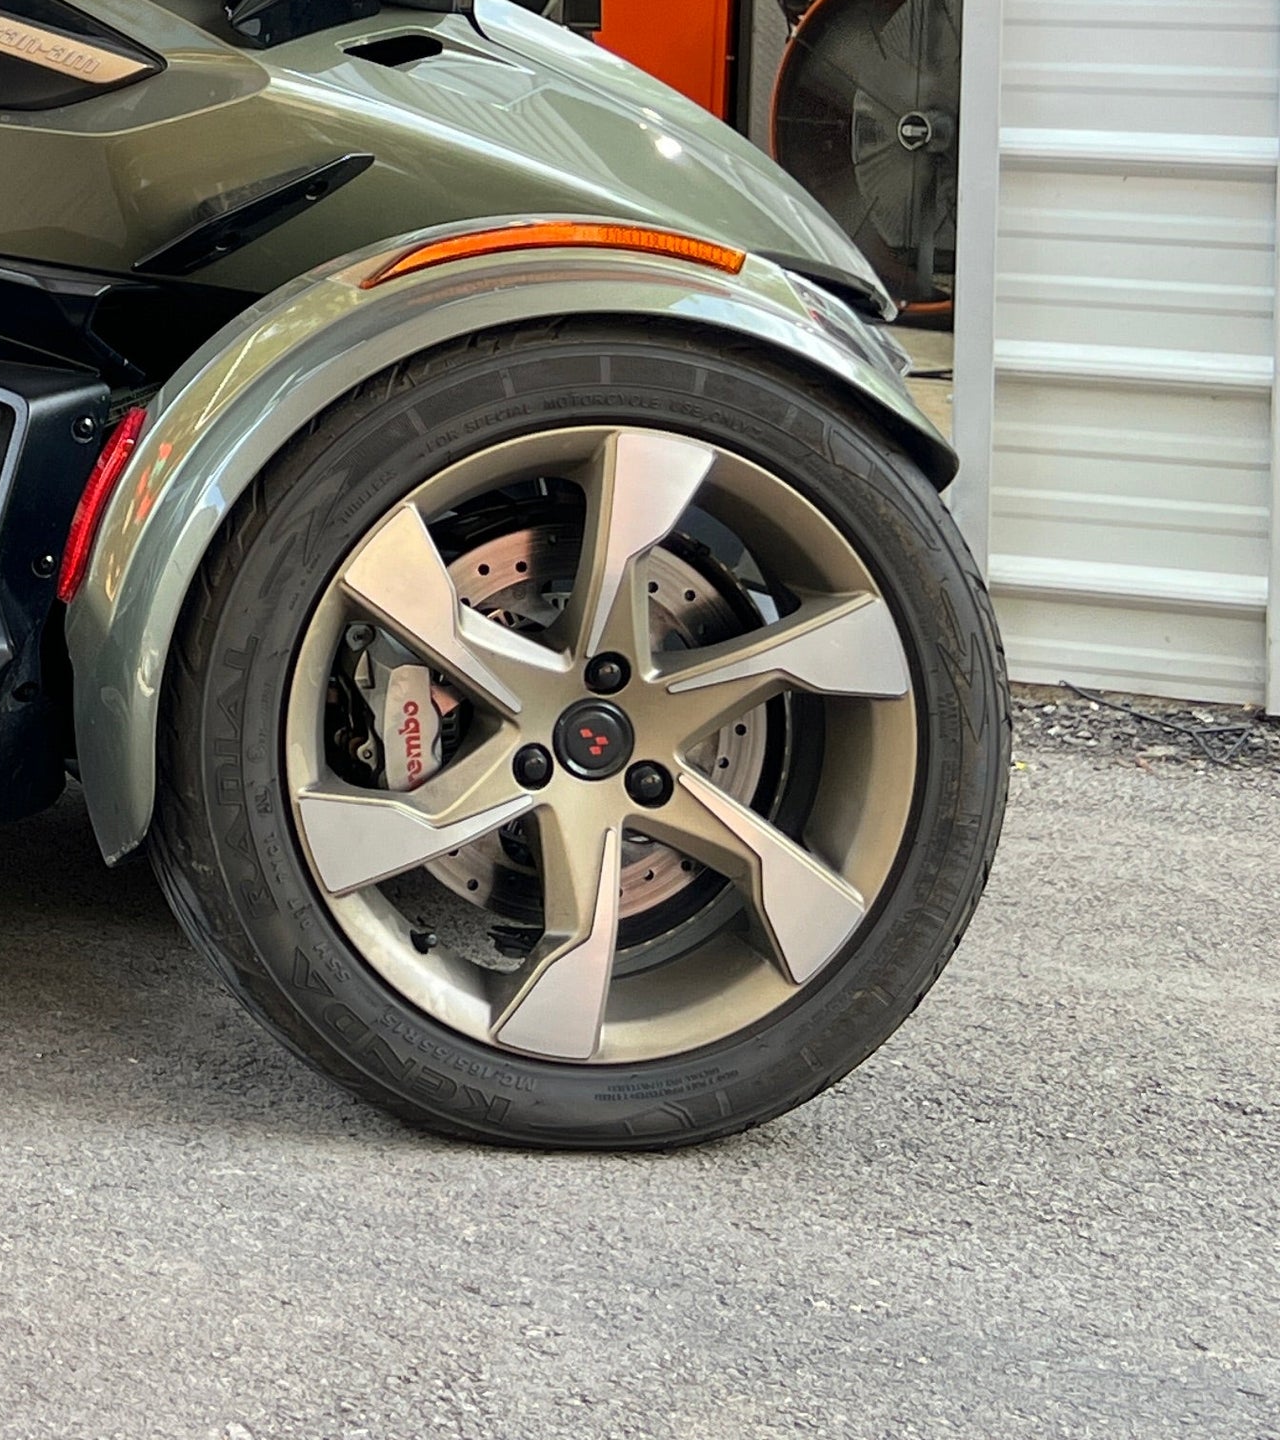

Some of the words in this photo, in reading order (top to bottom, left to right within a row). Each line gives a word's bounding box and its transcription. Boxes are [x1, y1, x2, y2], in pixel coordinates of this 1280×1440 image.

[425, 428, 458, 452] FOR
[461, 400, 532, 435] SPECIAL
[541, 389, 661, 411] MOTORCYCLE
[667, 396, 702, 418] USE
[214, 631, 274, 918] RADIAL
[398, 700, 424, 786] rembo
[290, 945, 512, 1123] KENDA
